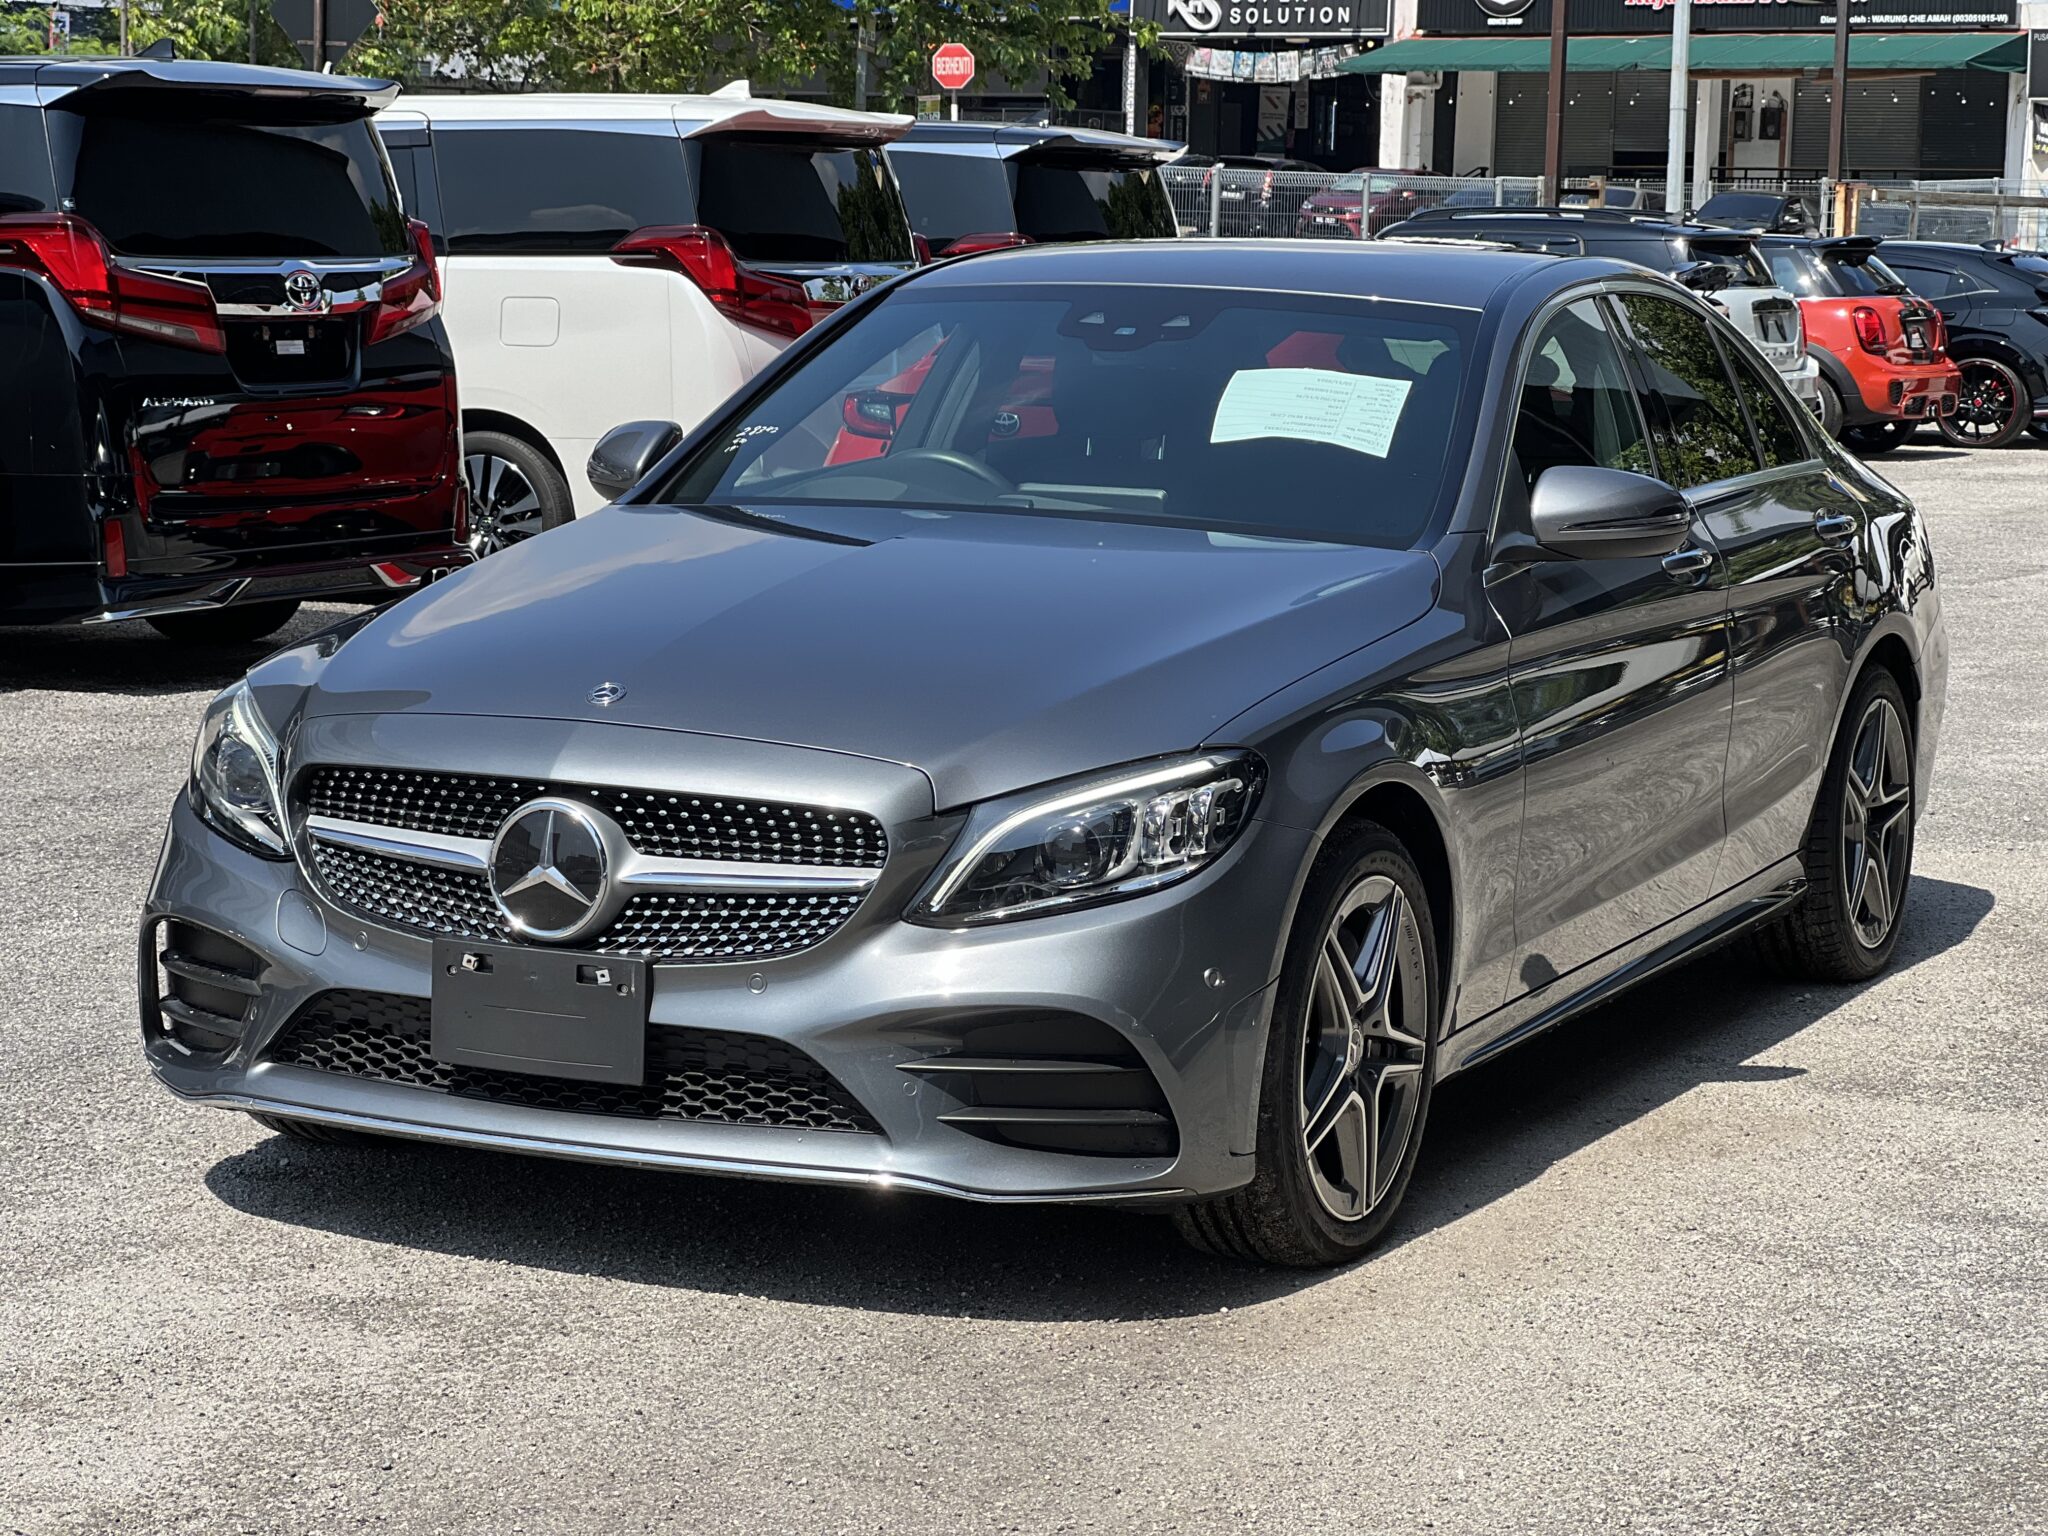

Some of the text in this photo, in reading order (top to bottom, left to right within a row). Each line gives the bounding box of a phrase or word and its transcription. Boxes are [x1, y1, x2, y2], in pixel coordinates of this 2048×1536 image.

[1229, 7, 1351, 25] SOLUTION
[1872, 15, 1908, 24] WARUNG
[1908, 14, 1926, 24] CHE
[1926, 14, 1951, 24] AMAH
[936, 56, 971, 75] BERHENTI
[142, 397, 215, 407] ALPHARD
